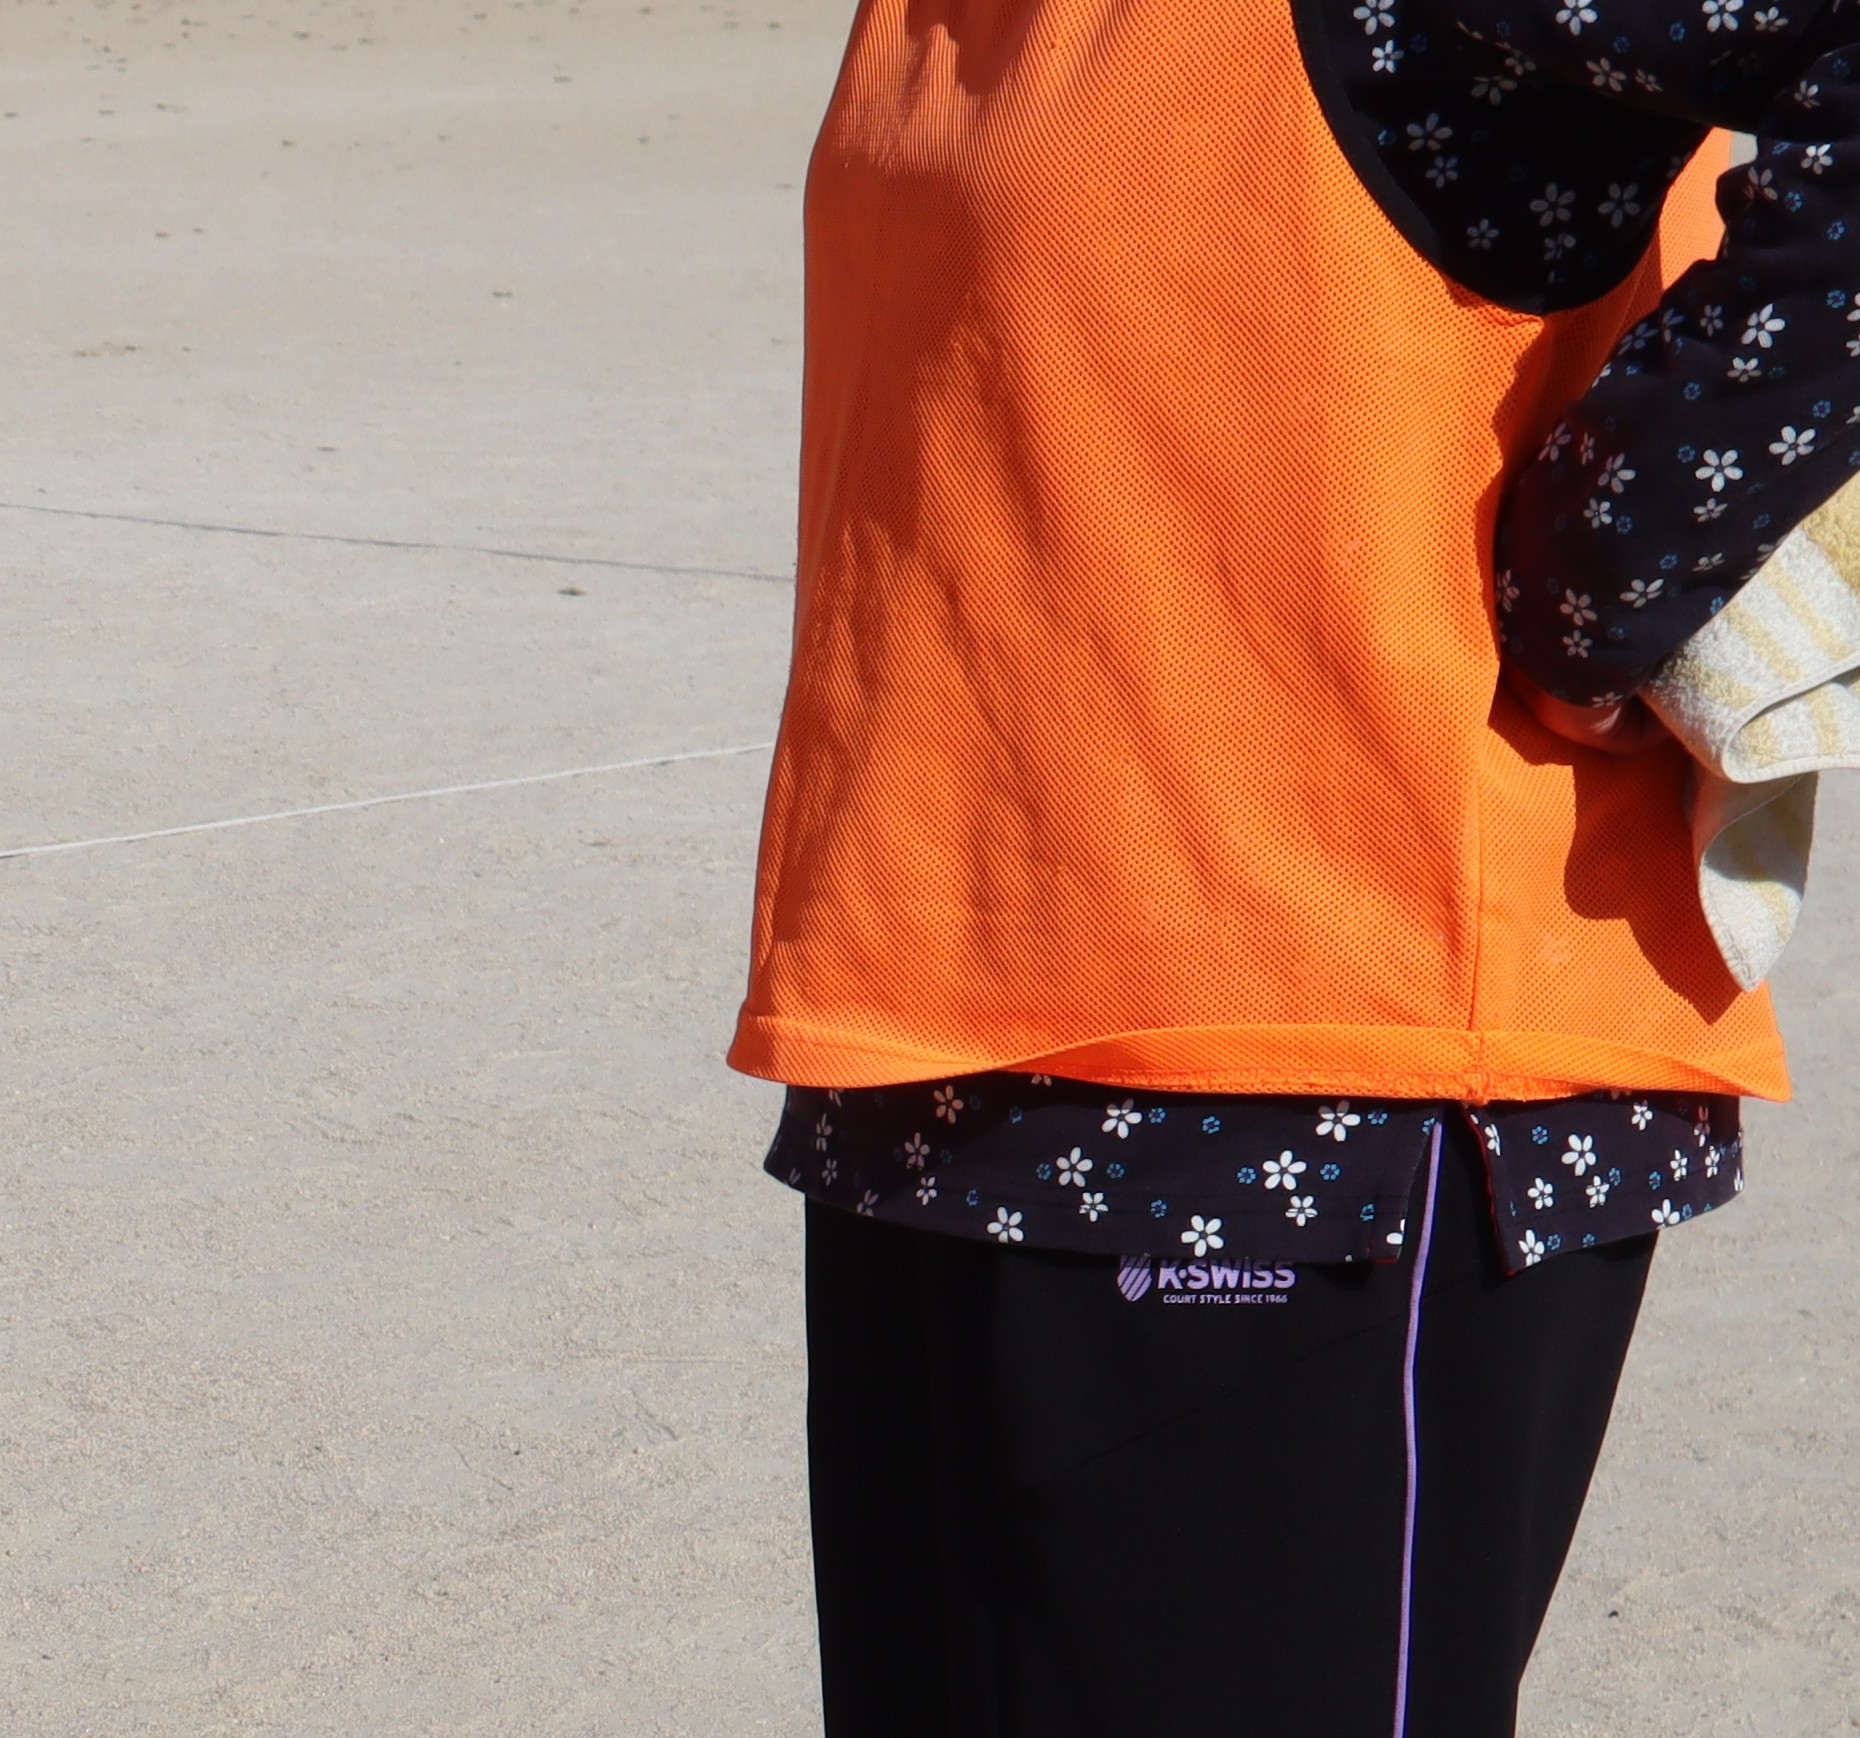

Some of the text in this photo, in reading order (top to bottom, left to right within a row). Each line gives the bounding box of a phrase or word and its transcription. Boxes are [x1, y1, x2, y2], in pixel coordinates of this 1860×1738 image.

[1163, 1293, 1197, 1304] COURT
[1199, 1293, 1232, 1305] STYLE
[1234, 1293, 1264, 1304] SINCE
